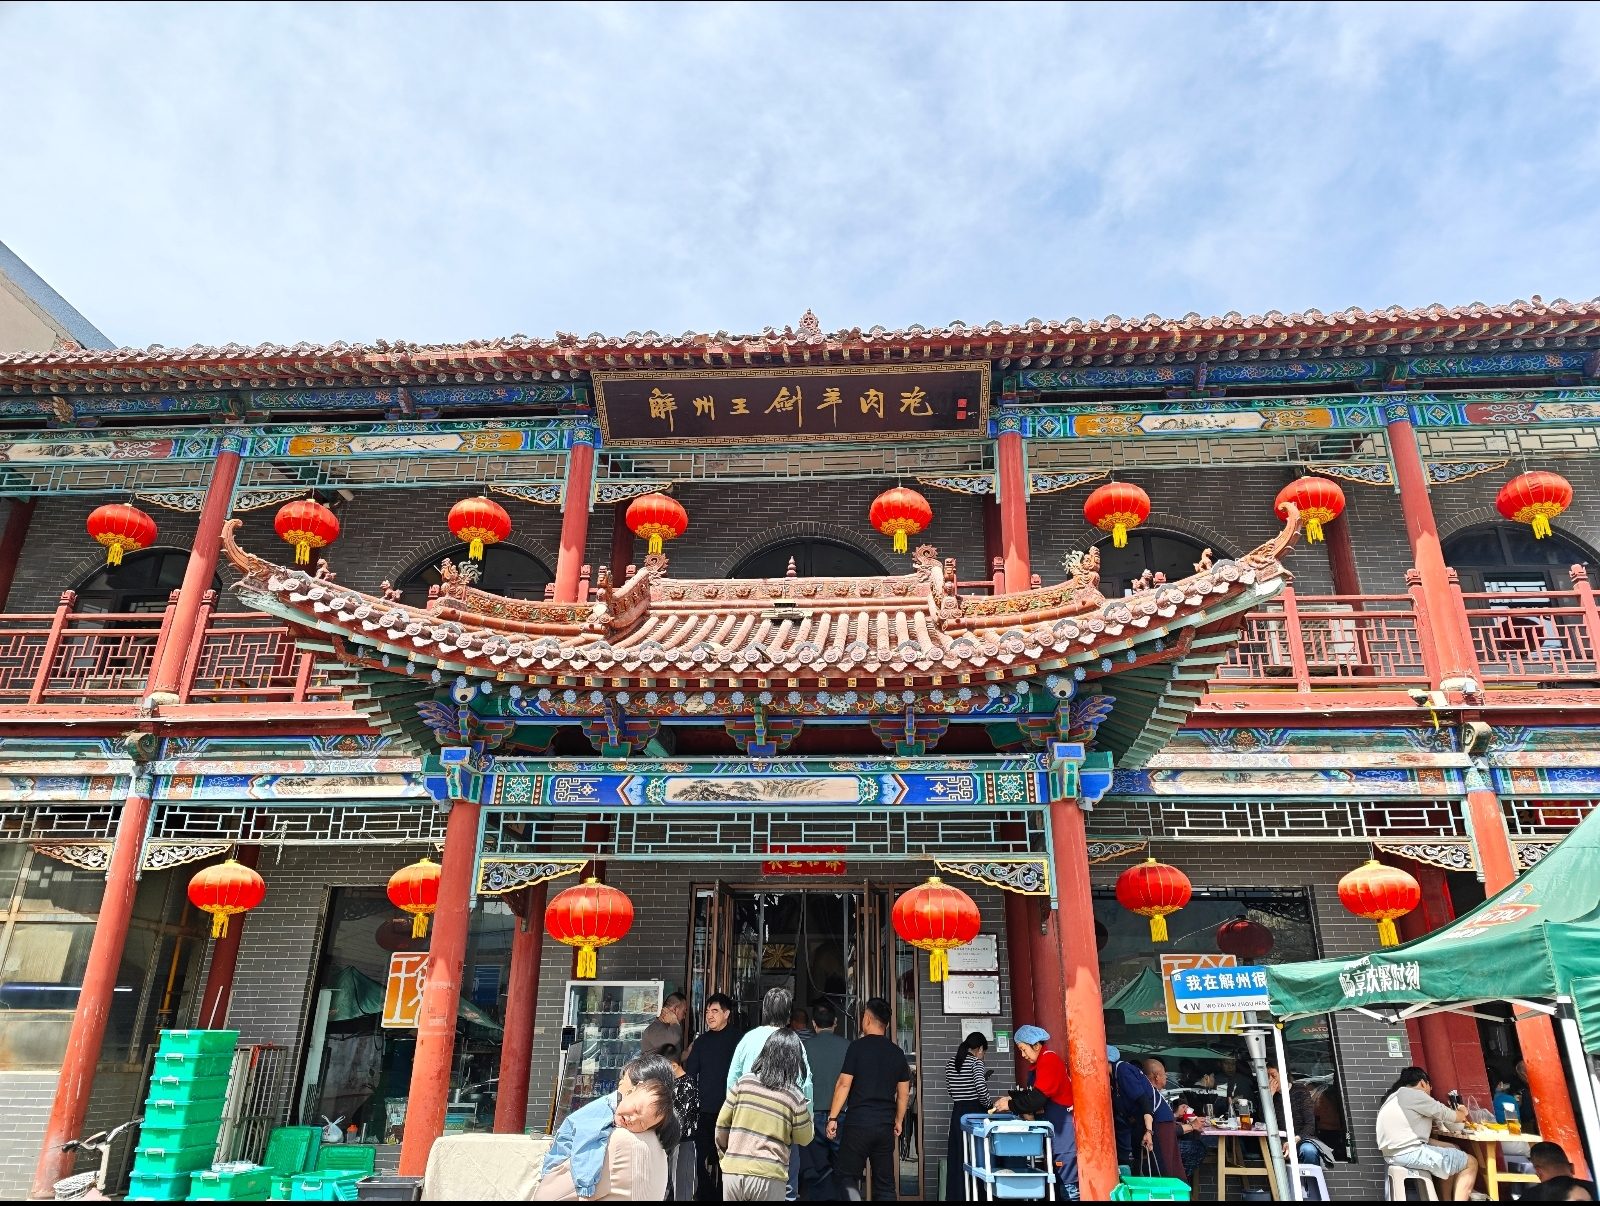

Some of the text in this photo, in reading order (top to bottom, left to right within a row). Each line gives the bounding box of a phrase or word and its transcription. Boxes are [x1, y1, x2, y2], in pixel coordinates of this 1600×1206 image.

[1186, 971, 1267, 991] 我在解州很
[1338, 960, 1421, 999] 畅享欢聚时刻
[1190, 1002, 1201, 1011] W
